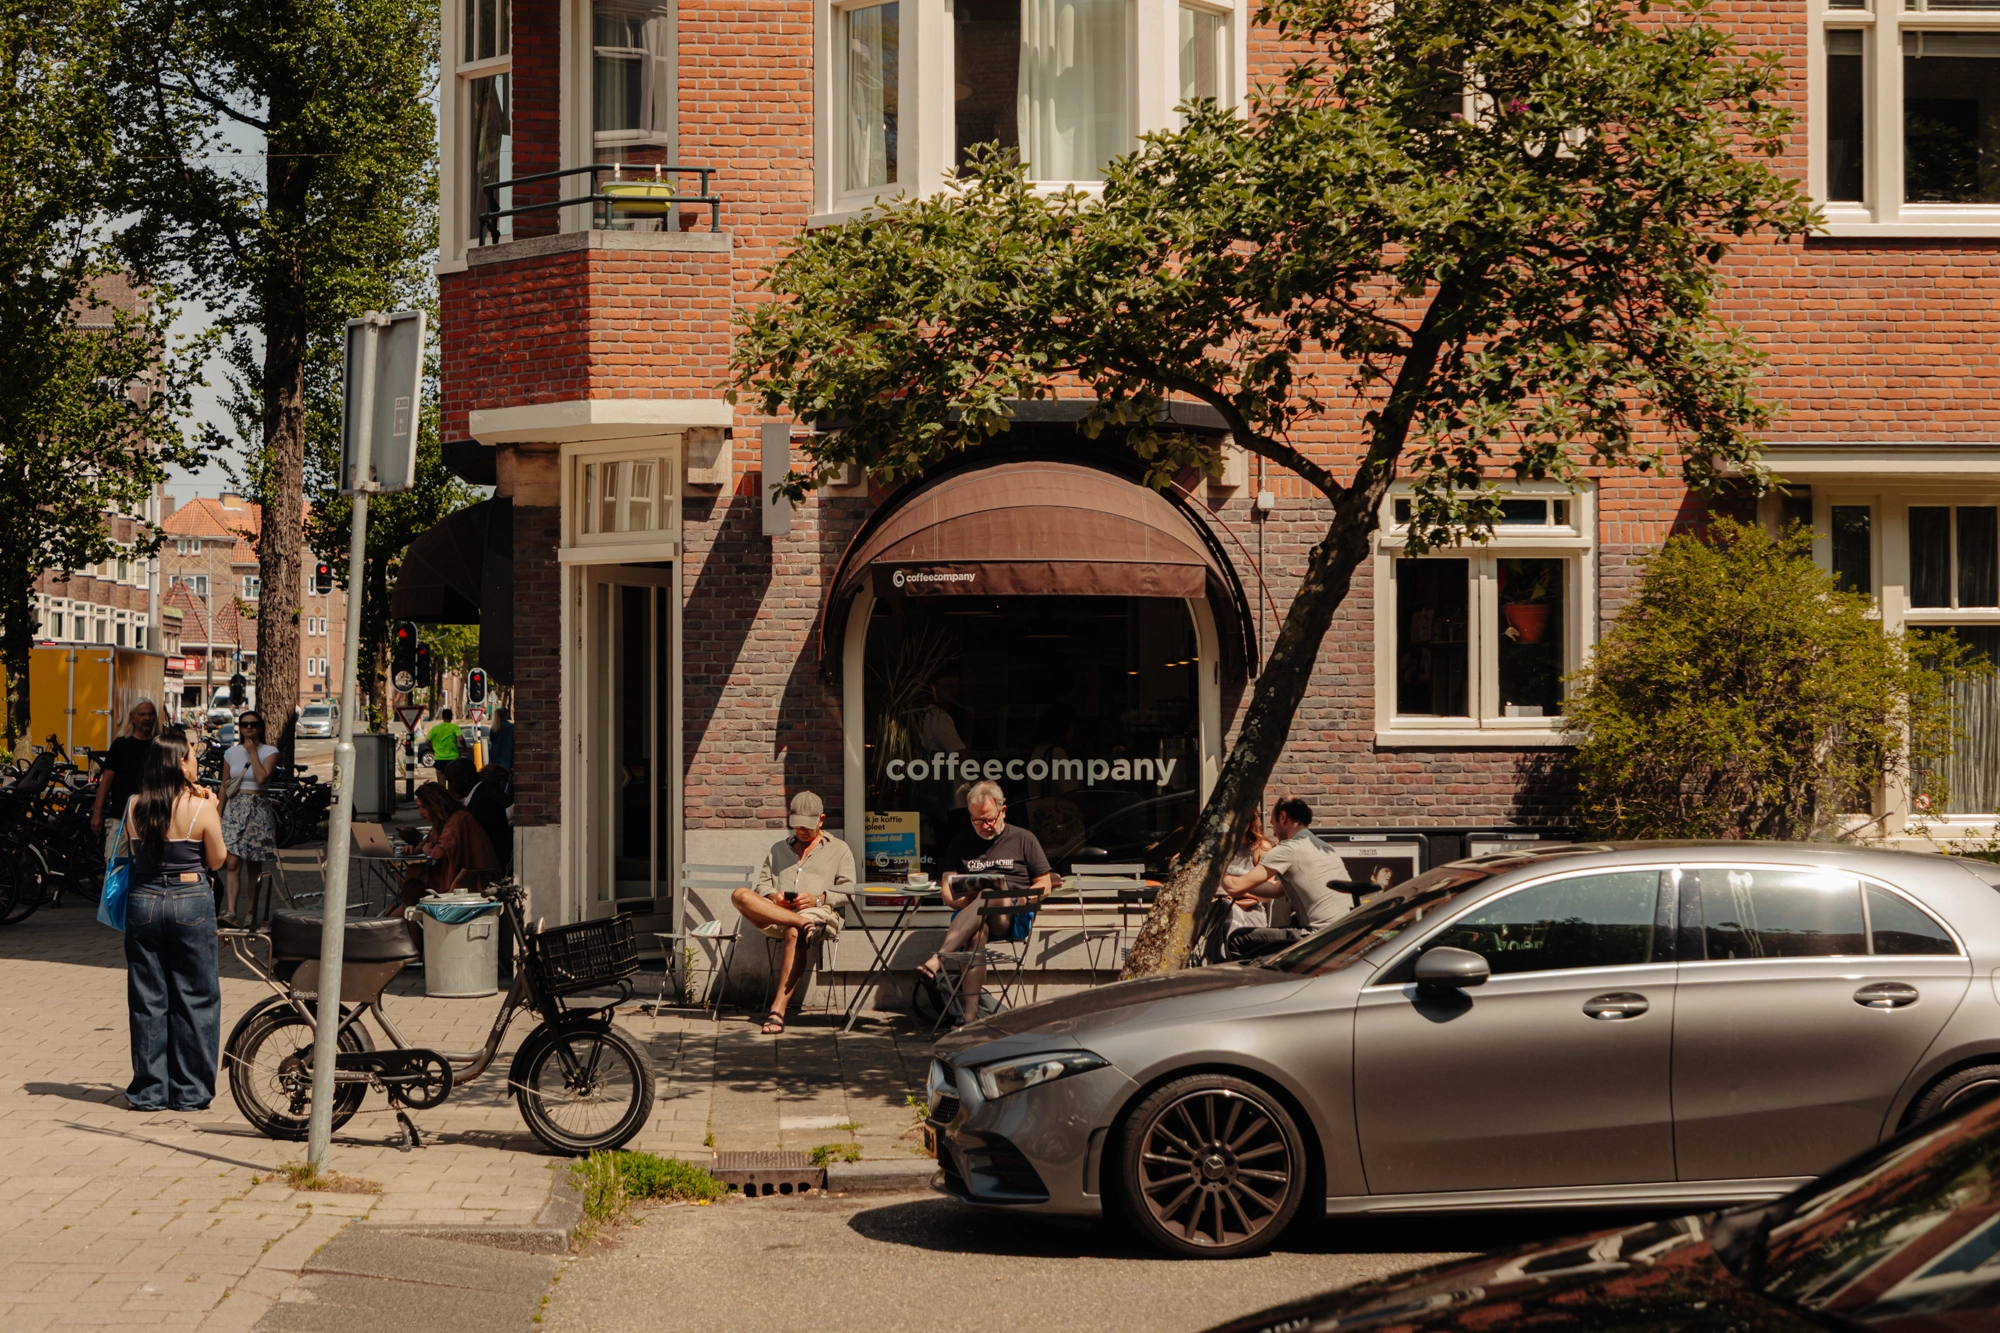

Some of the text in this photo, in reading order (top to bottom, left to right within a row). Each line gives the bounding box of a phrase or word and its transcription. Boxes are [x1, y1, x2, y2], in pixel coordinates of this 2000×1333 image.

[906, 573, 976, 583] coffeecompany
[886, 752, 1177, 786] coffeecompany
[872, 816, 879, 824] je
[294, 990, 318, 999] doppio
[496, 1007, 510, 1031] doppio
